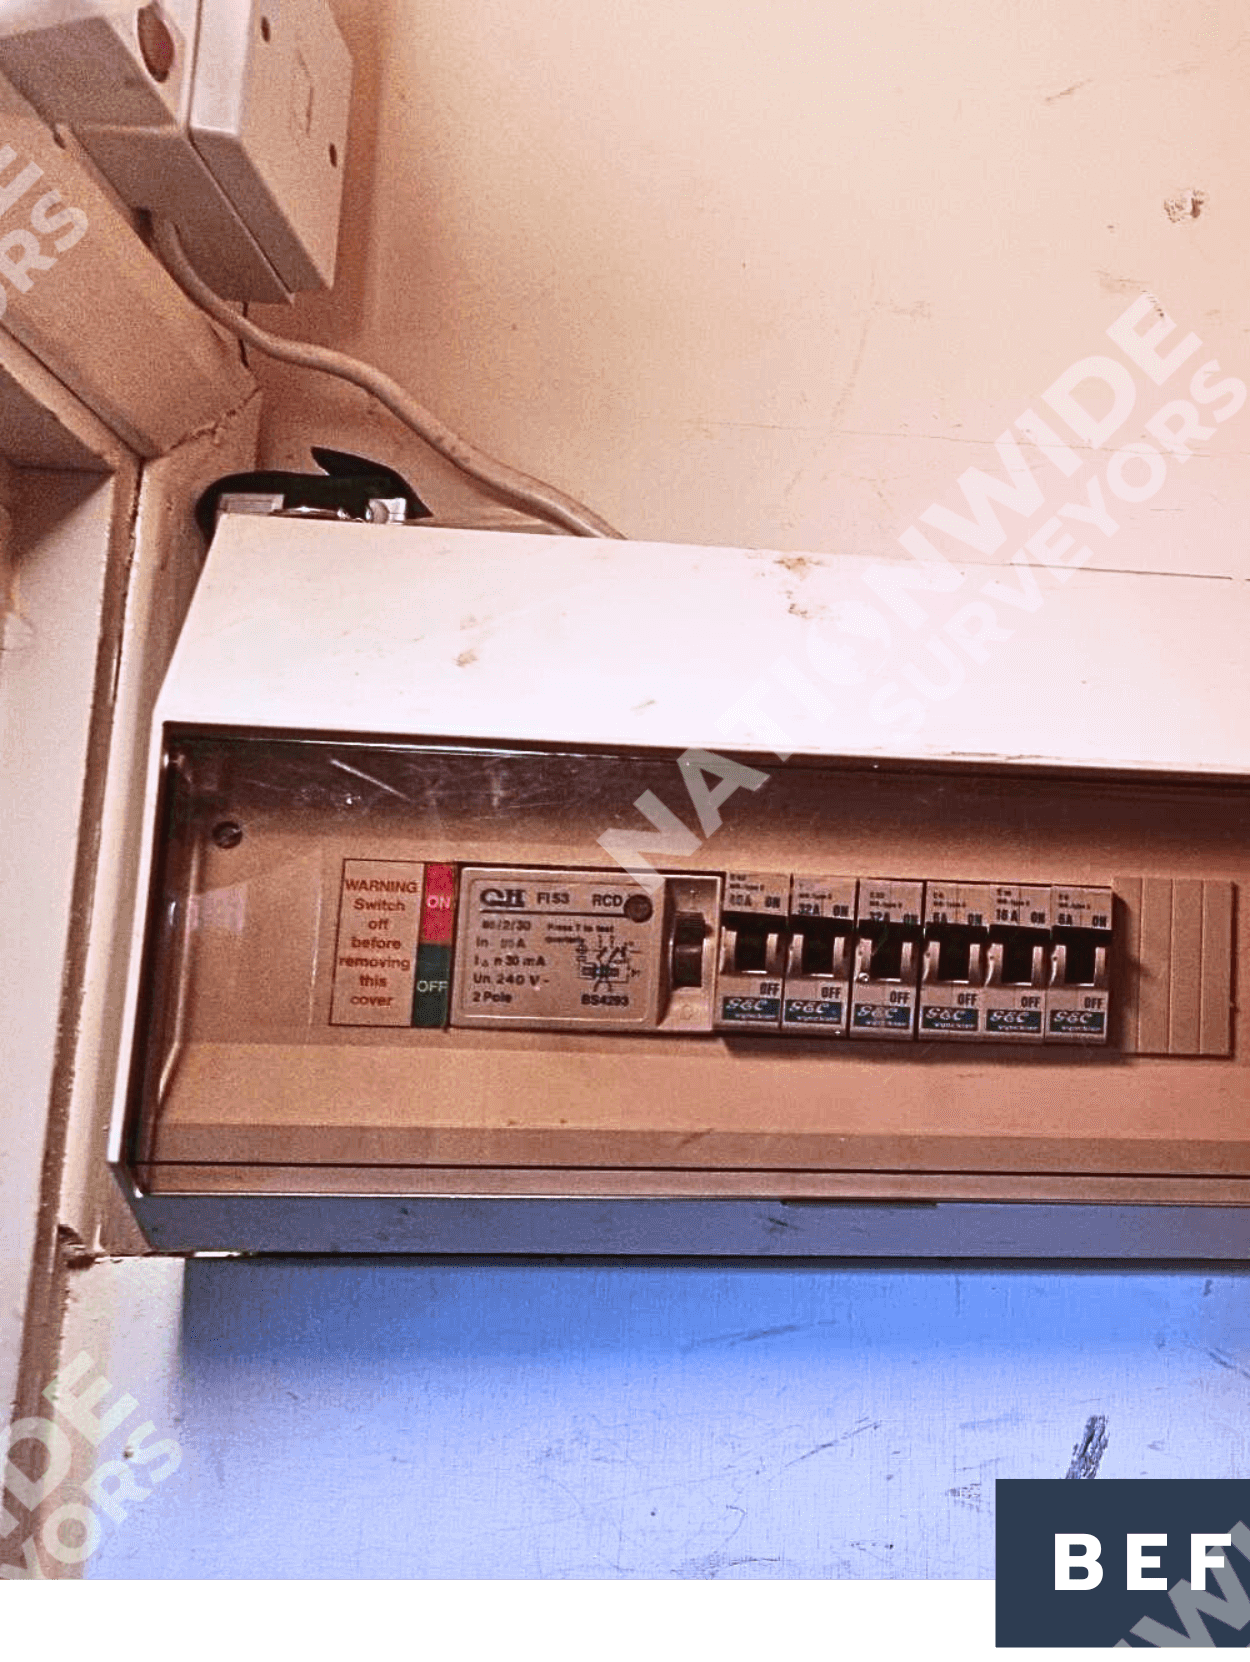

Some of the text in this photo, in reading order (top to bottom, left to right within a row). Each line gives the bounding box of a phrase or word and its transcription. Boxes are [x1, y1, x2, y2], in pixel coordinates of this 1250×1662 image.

[346, 879, 417, 892] WARNING
[353, 898, 406, 911] Switch
[426, 895, 451, 908] ON
[592, 894, 623, 907] RCD
[368, 918, 388, 930] off
[351, 936, 401, 949] before
[339, 956, 410, 971] removing
[359, 974, 387, 987] this
[416, 980, 448, 992] OFF
[760, 983, 780, 996] OFF
[821, 987, 841, 999] OFF
[350, 996, 394, 1006] cover
[889, 991, 910, 1003] OFF
[958, 993, 978, 1005] OFF
[1021, 997, 1041, 1008] OFF
[1084, 997, 1103, 1009] OFF
